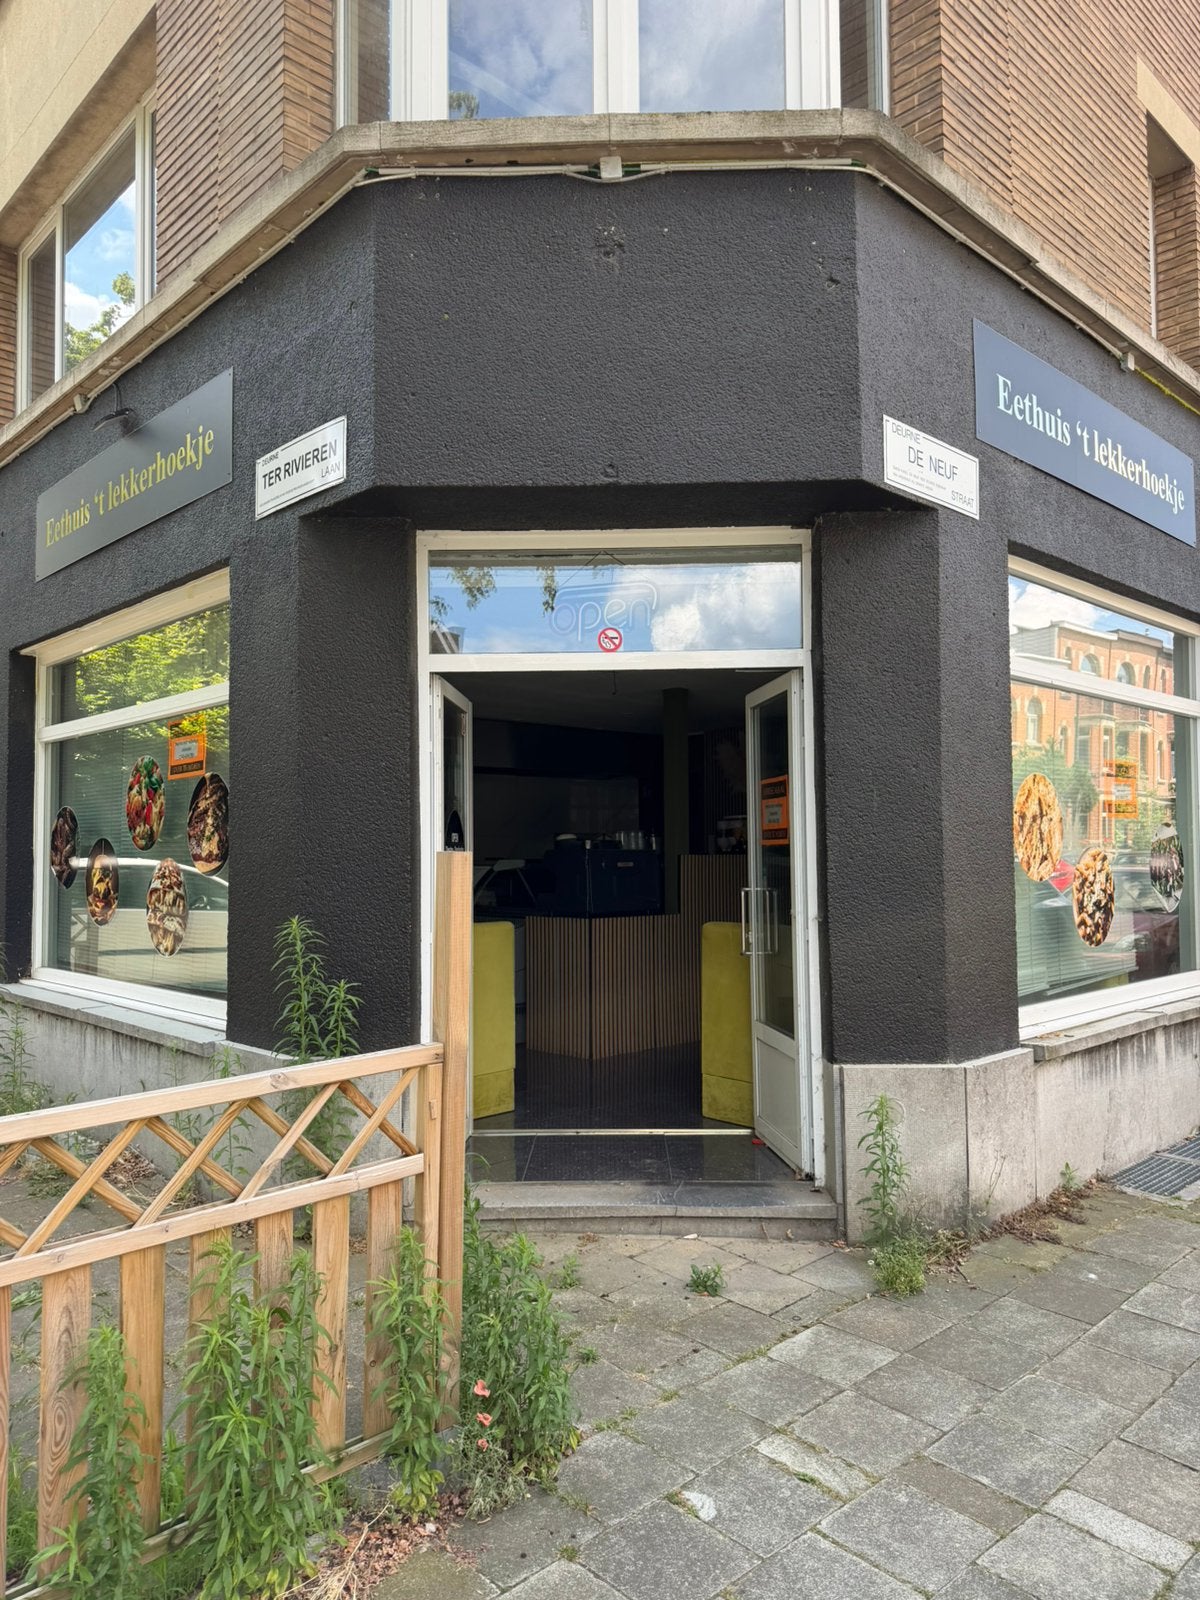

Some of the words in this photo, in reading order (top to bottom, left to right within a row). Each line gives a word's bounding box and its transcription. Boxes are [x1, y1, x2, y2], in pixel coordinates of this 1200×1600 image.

[891, 422, 921, 445] DEURNE
[996, 373, 1071, 447] Eethuis
[1093, 429, 1185, 515] lekkerhoekje
[262, 466, 282, 490] TER
[283, 439, 337, 480] RIVIEREN
[321, 461, 341, 478] LAAN
[908, 446, 924, 468] DE
[929, 455, 959, 481] NEUF
[45, 498, 90, 548] Eethuis
[107, 425, 215, 511] lekkerhoekje
[951, 490, 974, 508] STRAAT
[552, 598, 650, 642] open
